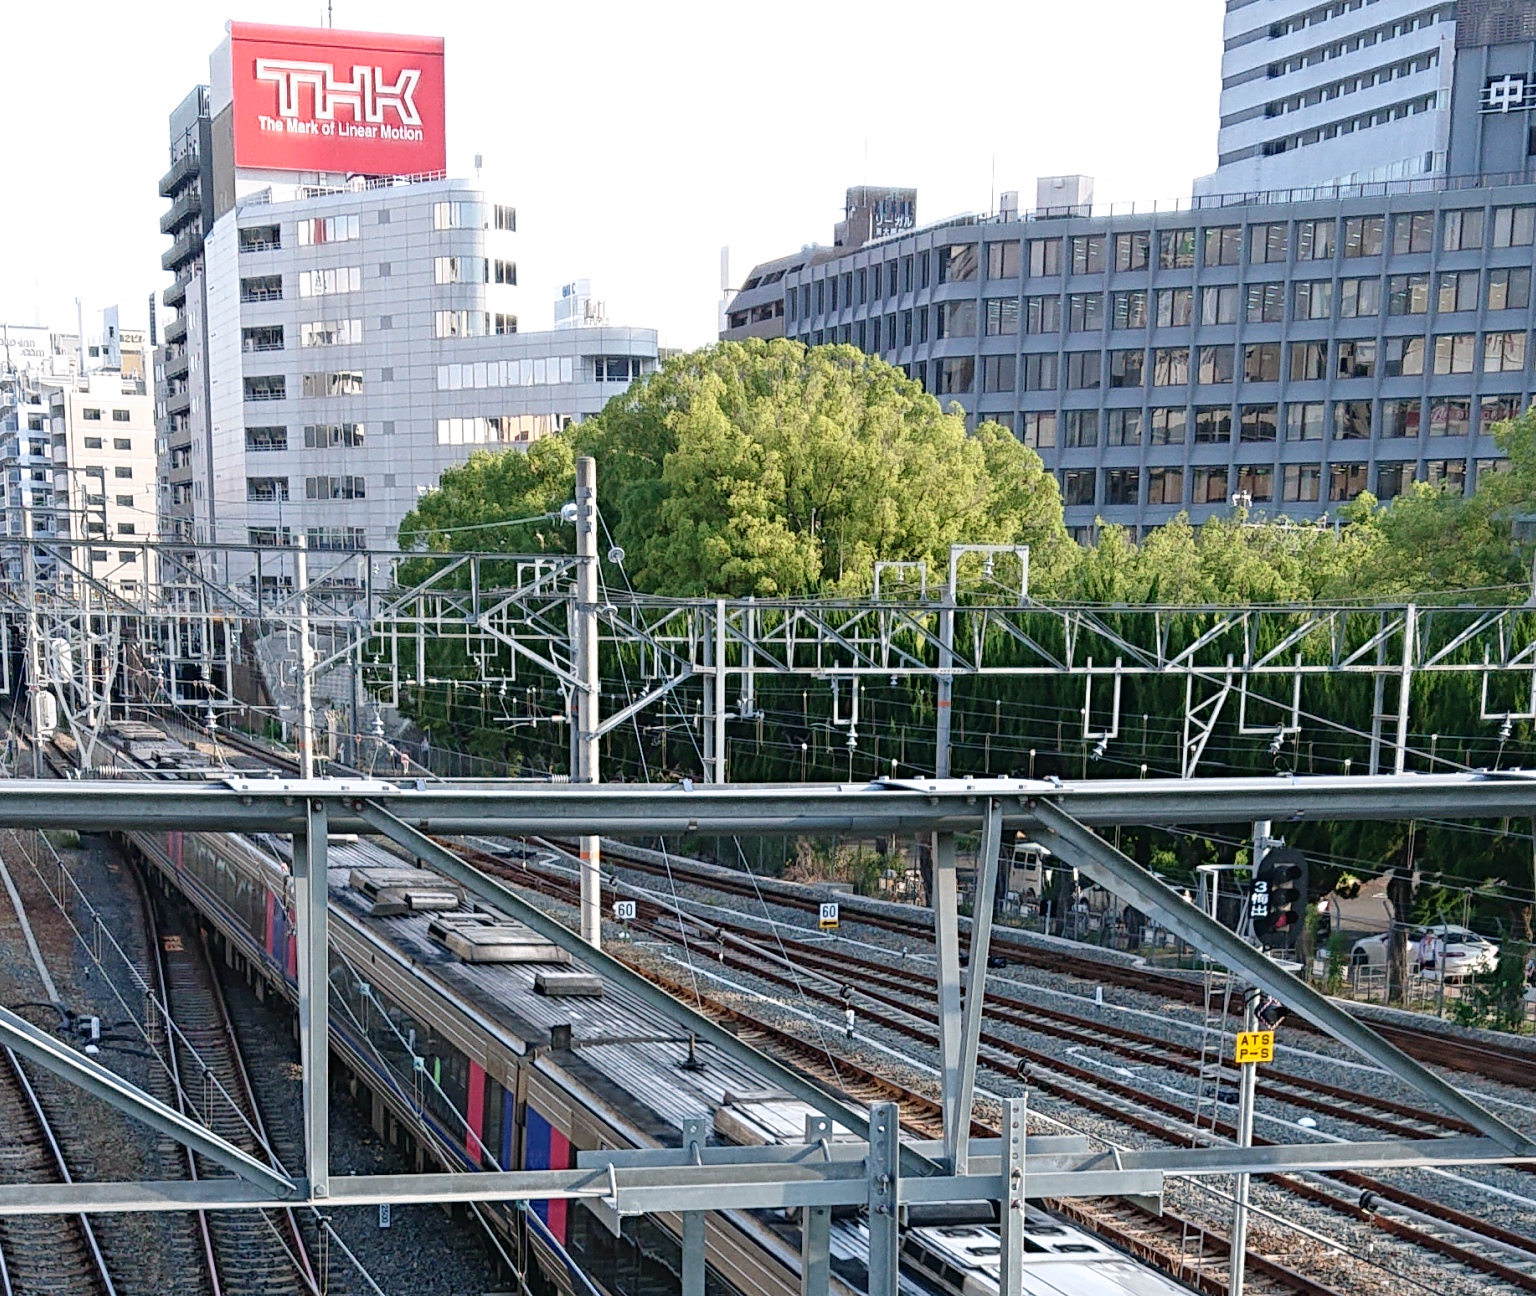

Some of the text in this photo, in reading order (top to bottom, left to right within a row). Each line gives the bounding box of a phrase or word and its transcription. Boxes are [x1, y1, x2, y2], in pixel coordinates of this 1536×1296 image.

[255, 57, 423, 126] THK
[258, 115, 423, 142] The Mark of Linear Motion
[618, 903, 633, 916] 60
[822, 905, 836, 918] 60
[1241, 1034, 1270, 1046] ATS
